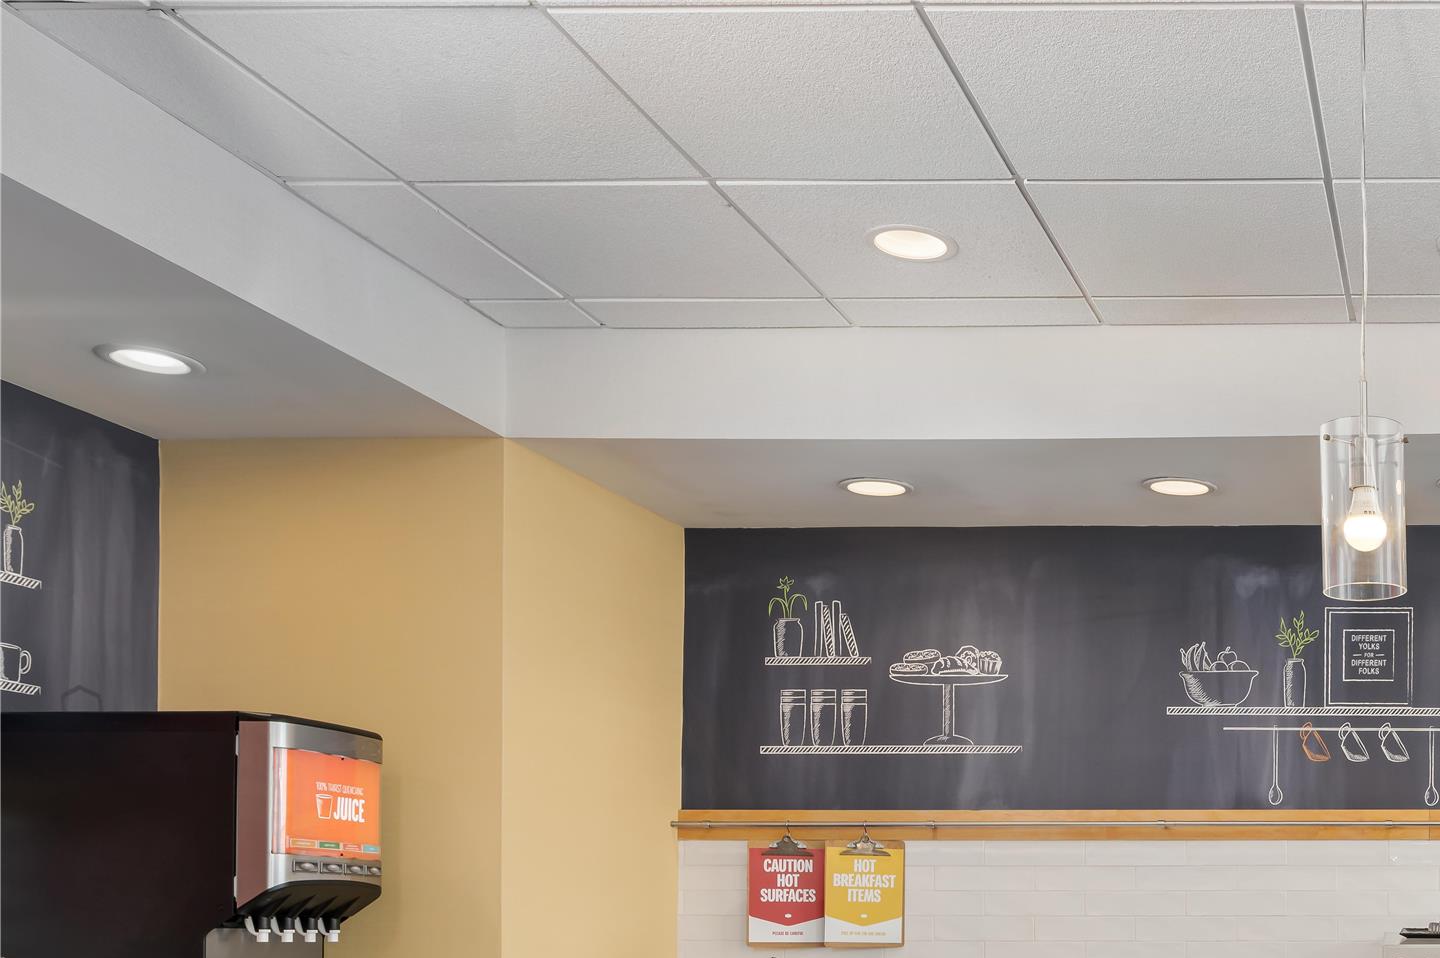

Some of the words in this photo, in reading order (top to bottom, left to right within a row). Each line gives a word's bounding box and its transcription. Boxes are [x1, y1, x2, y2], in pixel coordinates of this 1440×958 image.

[1351, 634, 1387, 642] DIFFERENT
[1351, 659, 1387, 667] DIFFERENT
[1358, 667, 1380, 675] FOLKS
[333, 796, 366, 823] JUICE
[763, 858, 814, 873] CAUTION
[853, 859, 877, 873] HOT
[776, 873, 800, 888] HOT
[832, 873, 897, 889] BREAKFAST
[760, 888, 817, 903] SURFACES
[847, 888, 881, 903] ITEMS
